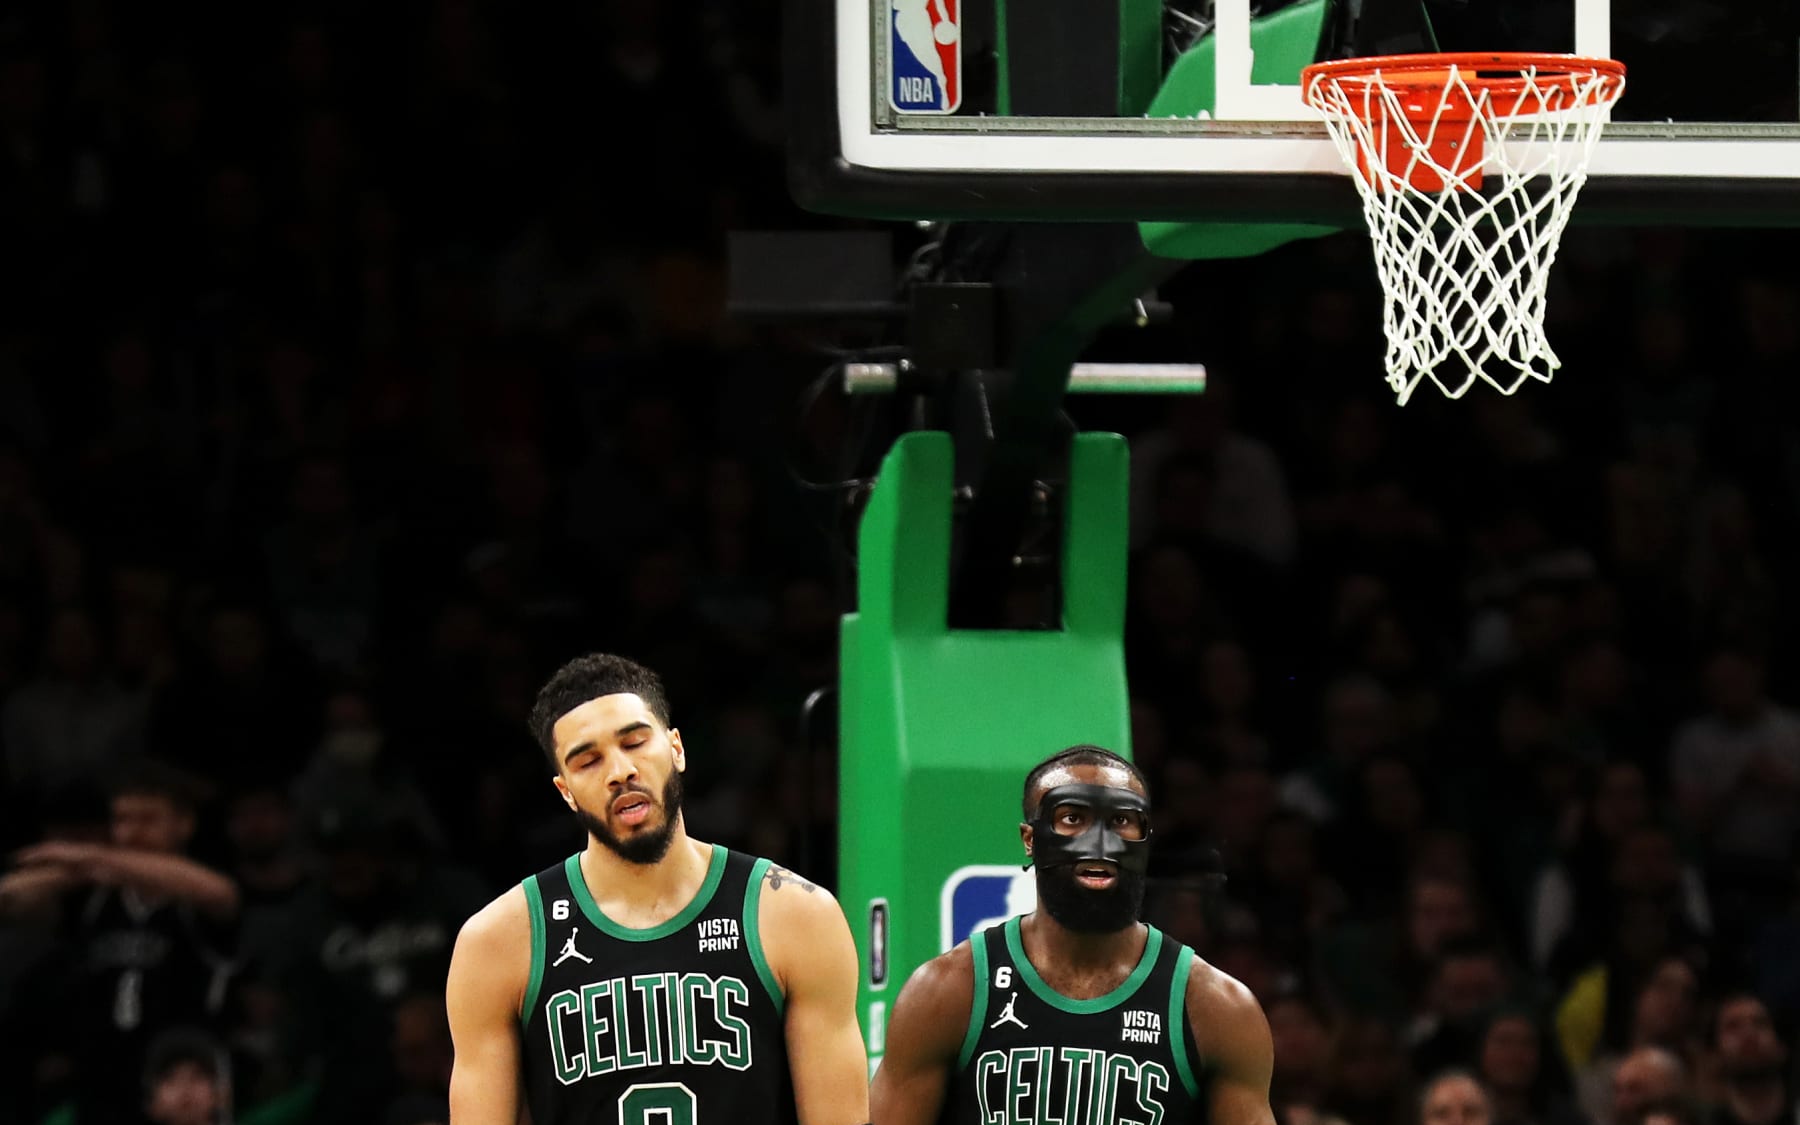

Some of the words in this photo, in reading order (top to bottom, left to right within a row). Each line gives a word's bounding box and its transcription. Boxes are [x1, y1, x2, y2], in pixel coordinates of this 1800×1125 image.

[898, 76, 934, 103] NBA
[552, 900, 570, 920] 6
[698, 918, 739, 939] VISTA
[699, 936, 739, 952] PRINT
[995, 966, 1012, 989] 6
[545, 972, 752, 1086] CELTICS
[1123, 1010, 1161, 1032] VISTA
[1121, 1028, 1161, 1044] PRINT
